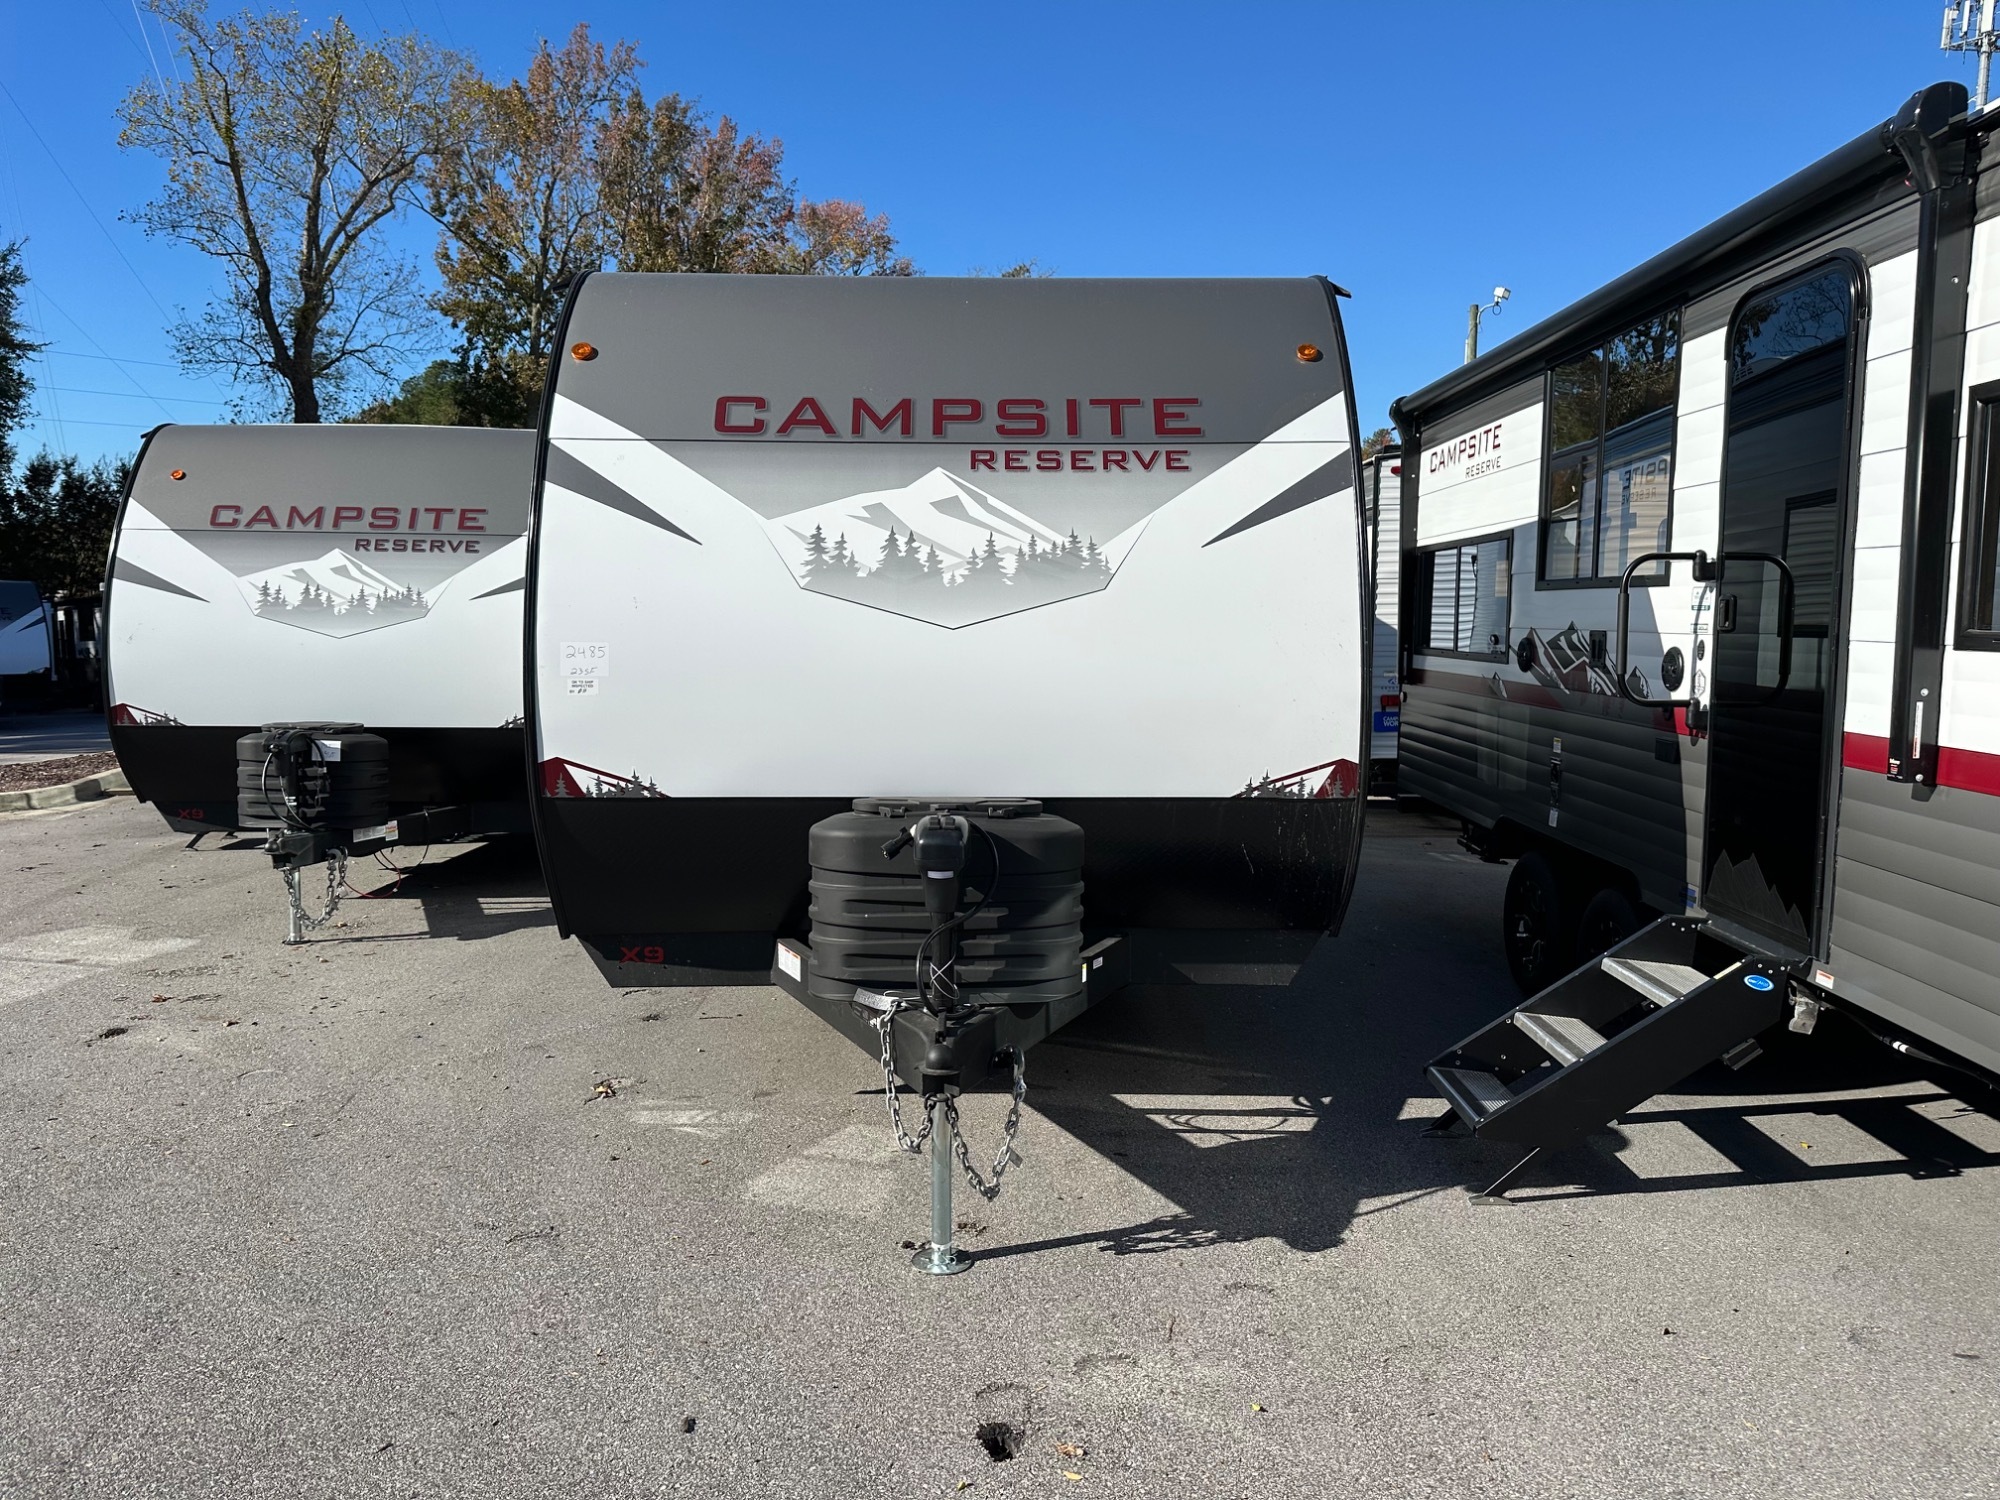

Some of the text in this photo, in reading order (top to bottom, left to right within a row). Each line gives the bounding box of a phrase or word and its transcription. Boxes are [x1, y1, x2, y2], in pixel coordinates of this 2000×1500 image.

[714, 395, 1203, 437] CAMPSITE
[1430, 424, 1502, 473] CAMPSITE
[970, 449, 1191, 471] RESERVE
[1465, 456, 1502, 478] RESERVE
[209, 505, 488, 531] CAMPSITE
[354, 538, 481, 553] RESERVE
[566, 645, 606, 659] 2485
[179, 808, 204, 820] X9
[619, 946, 665, 965] X9
